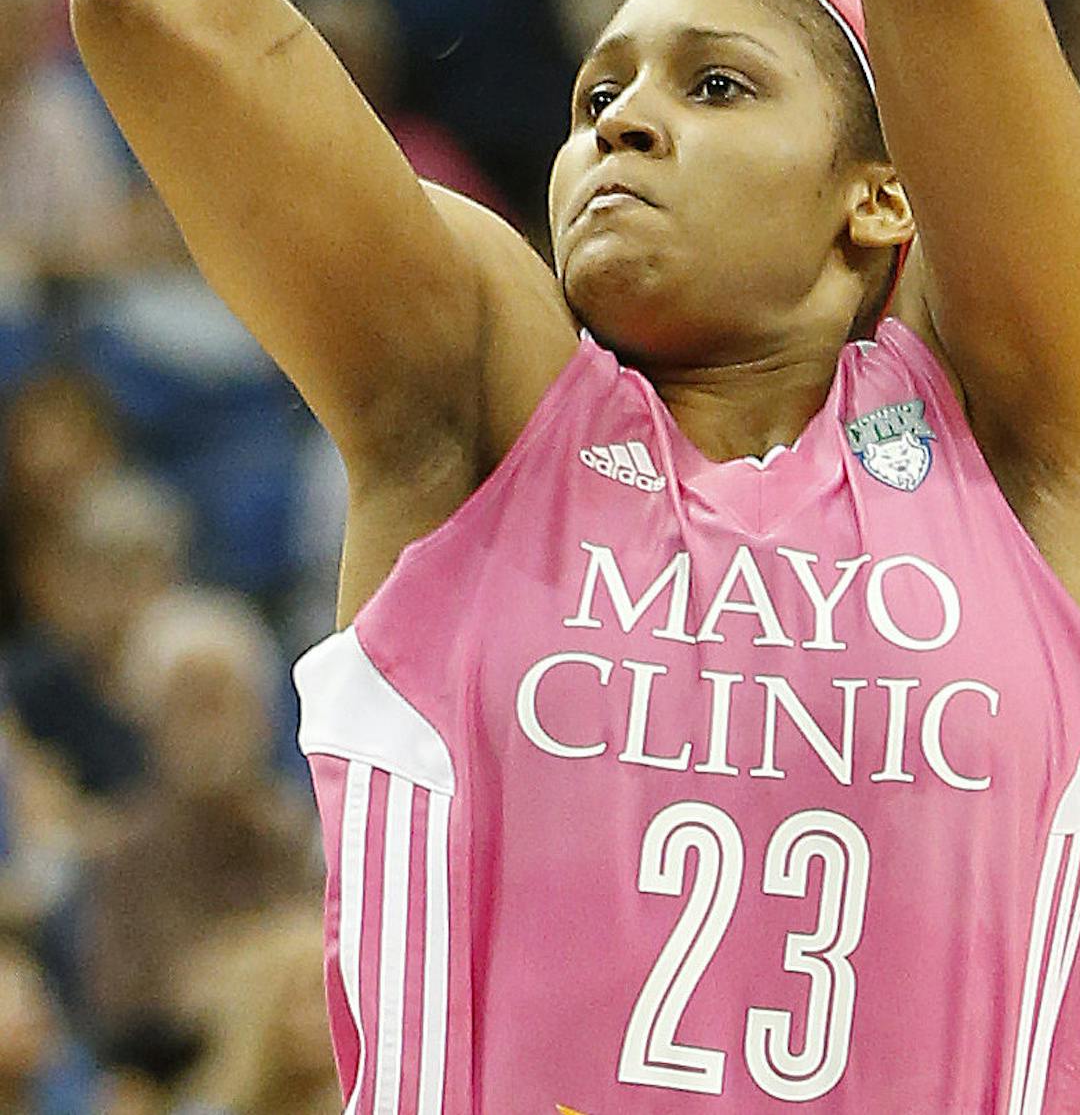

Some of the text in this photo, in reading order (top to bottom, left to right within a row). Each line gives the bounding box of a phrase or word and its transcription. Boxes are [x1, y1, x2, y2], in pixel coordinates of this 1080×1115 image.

[579, 449, 667, 493] adidas
[562, 540, 962, 652] MAYO
[515, 651, 1001, 791] CLINIC
[617, 801, 871, 1102] 23
